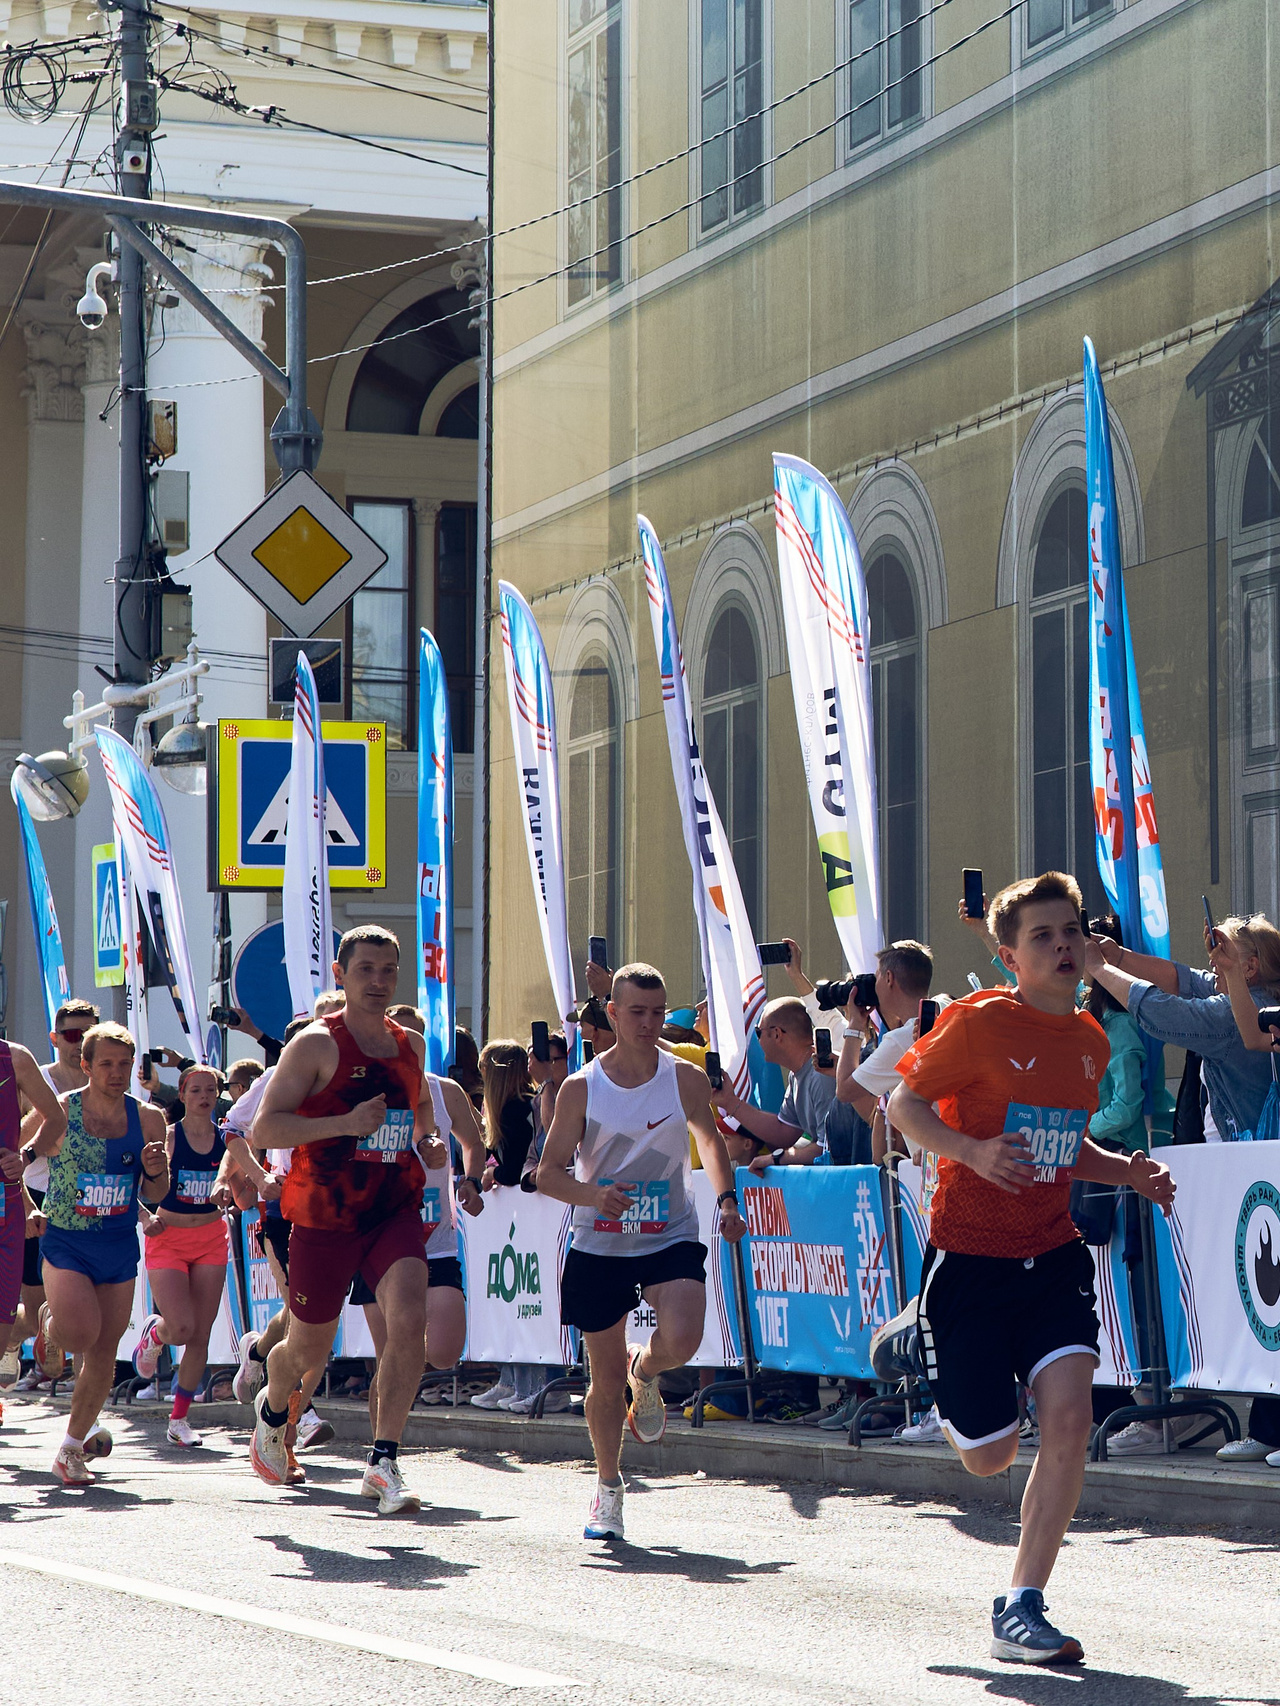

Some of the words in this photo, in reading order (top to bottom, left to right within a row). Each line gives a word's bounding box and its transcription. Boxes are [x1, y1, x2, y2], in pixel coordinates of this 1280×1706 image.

[368, 1124, 409, 1150] 30513
[382, 1151, 396, 1163] 5KM
[83, 1185, 126, 1206] 30614
[1240, 1191, 1257, 1225] ТВЕРЬ
[1259, 1188, 1273, 1203] РАН
[622, 1222, 640, 1234] 5KM
[1237, 1245, 1251, 1311] ШКОЛА
[1251, 1313, 1267, 1342] БЕГА
